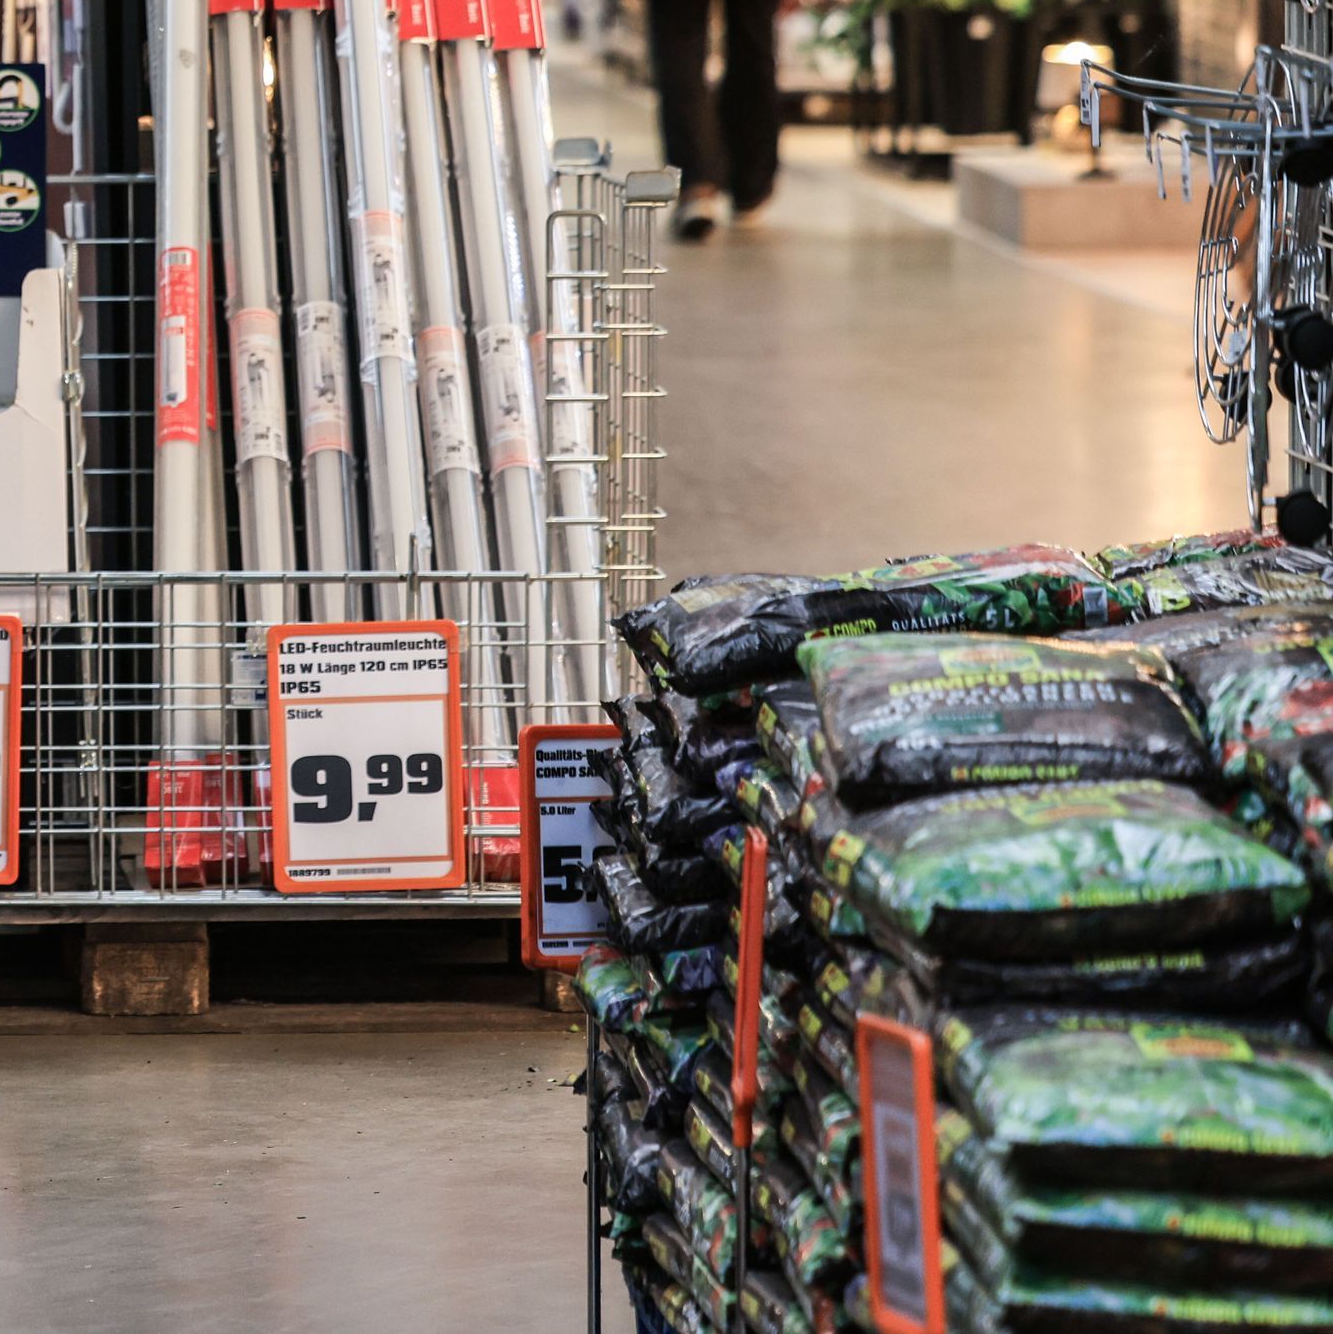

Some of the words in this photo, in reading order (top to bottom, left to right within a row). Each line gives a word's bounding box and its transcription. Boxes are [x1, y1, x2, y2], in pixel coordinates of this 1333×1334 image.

[985, 606, 998, 629] 5
[1005, 607, 1015, 628] L
[834, 617, 877, 637] COMPO
[280, 637, 447, 655] LED-Feuchtraumleuchte
[280, 663, 296, 675] 18
[300, 662, 314, 674] W
[317, 661, 356, 676] Länge
[360, 660, 386, 673] 120
[390, 662, 410, 672] cm
[413, 658, 448, 671] IP65
[280, 681, 321, 695] IP65
[287, 708, 323, 721] Stück
[536, 767, 577, 778] COMPO
[578, 767, 601, 778] SA
[290, 752, 443, 824] 9,99
[540, 806, 555, 815] 5.0
[557, 806, 576, 815] Liter
